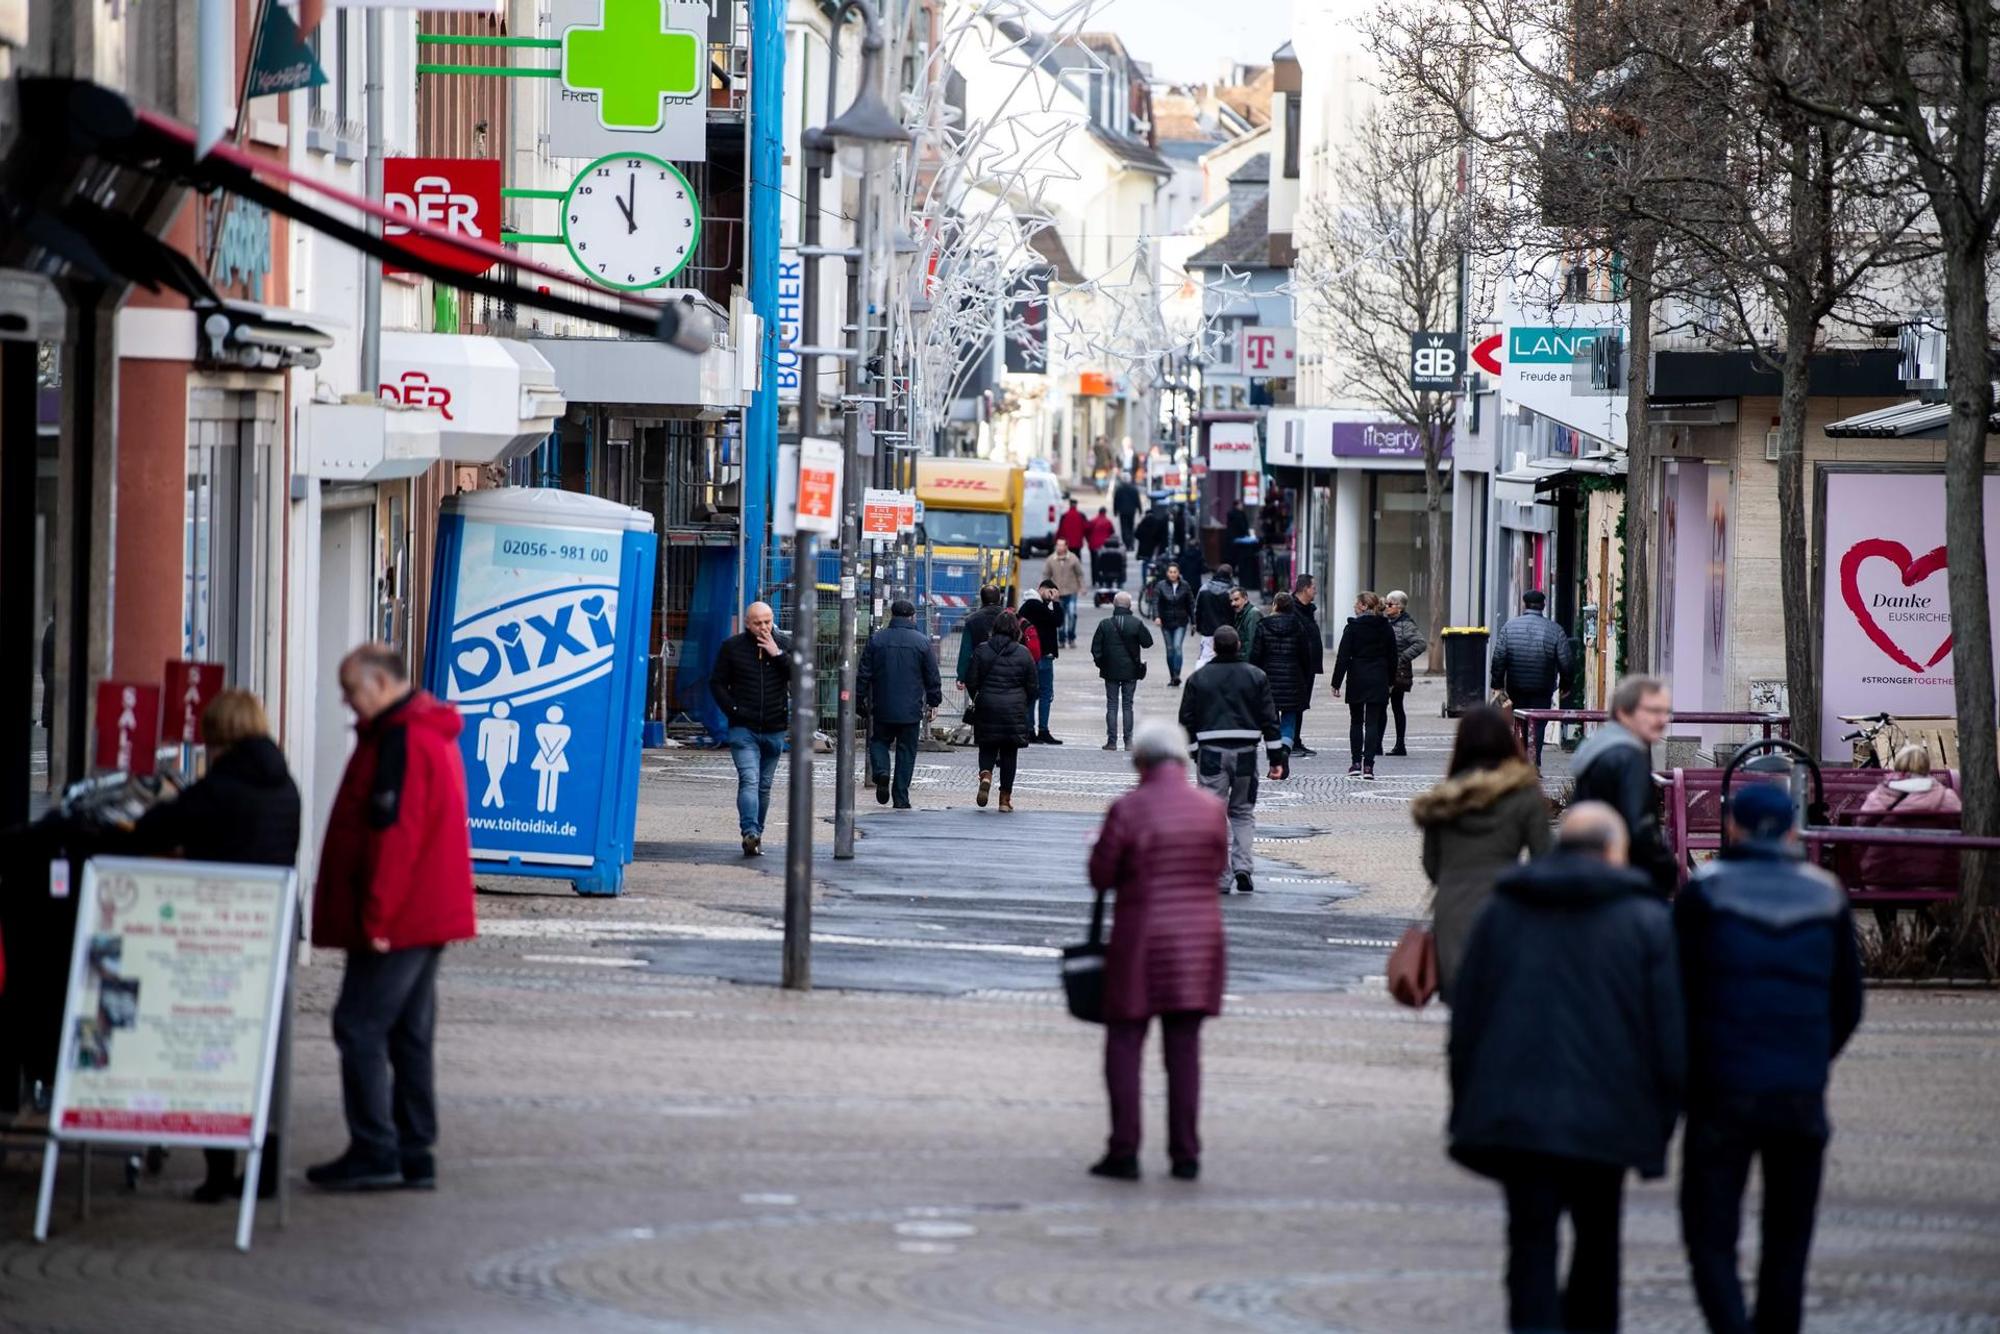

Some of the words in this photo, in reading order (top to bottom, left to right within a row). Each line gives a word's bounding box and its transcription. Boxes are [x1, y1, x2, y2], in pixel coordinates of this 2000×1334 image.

[627, 160, 641, 168] 12
[596, 168, 610, 177] 11
[660, 172, 665, 180] 1
[578, 186, 592, 195] 10
[676, 191, 684, 199] 2
[384, 192, 482, 238] DER
[570, 215, 578, 224] 9
[684, 218, 692, 227] 3
[578, 242, 587, 251] 8
[676, 246, 684, 255] 4
[599, 263, 606, 273] 7
[654, 266, 661, 275] 5
[627, 274, 635, 282] 6
[1520, 371, 1557, 381] Freude
[378, 384, 453, 421] DER
[934, 478, 988, 491] DHL
[503, 539, 547, 557] 02056
[560, 545, 586, 560] 981
[591, 549, 609, 563] 00
[1872, 593, 1932, 608] Danke
[1862, 676, 1955, 686] #STRONGERTOGETHE
[183, 666, 201, 742] SALE
[118, 686, 137, 772] SALE
